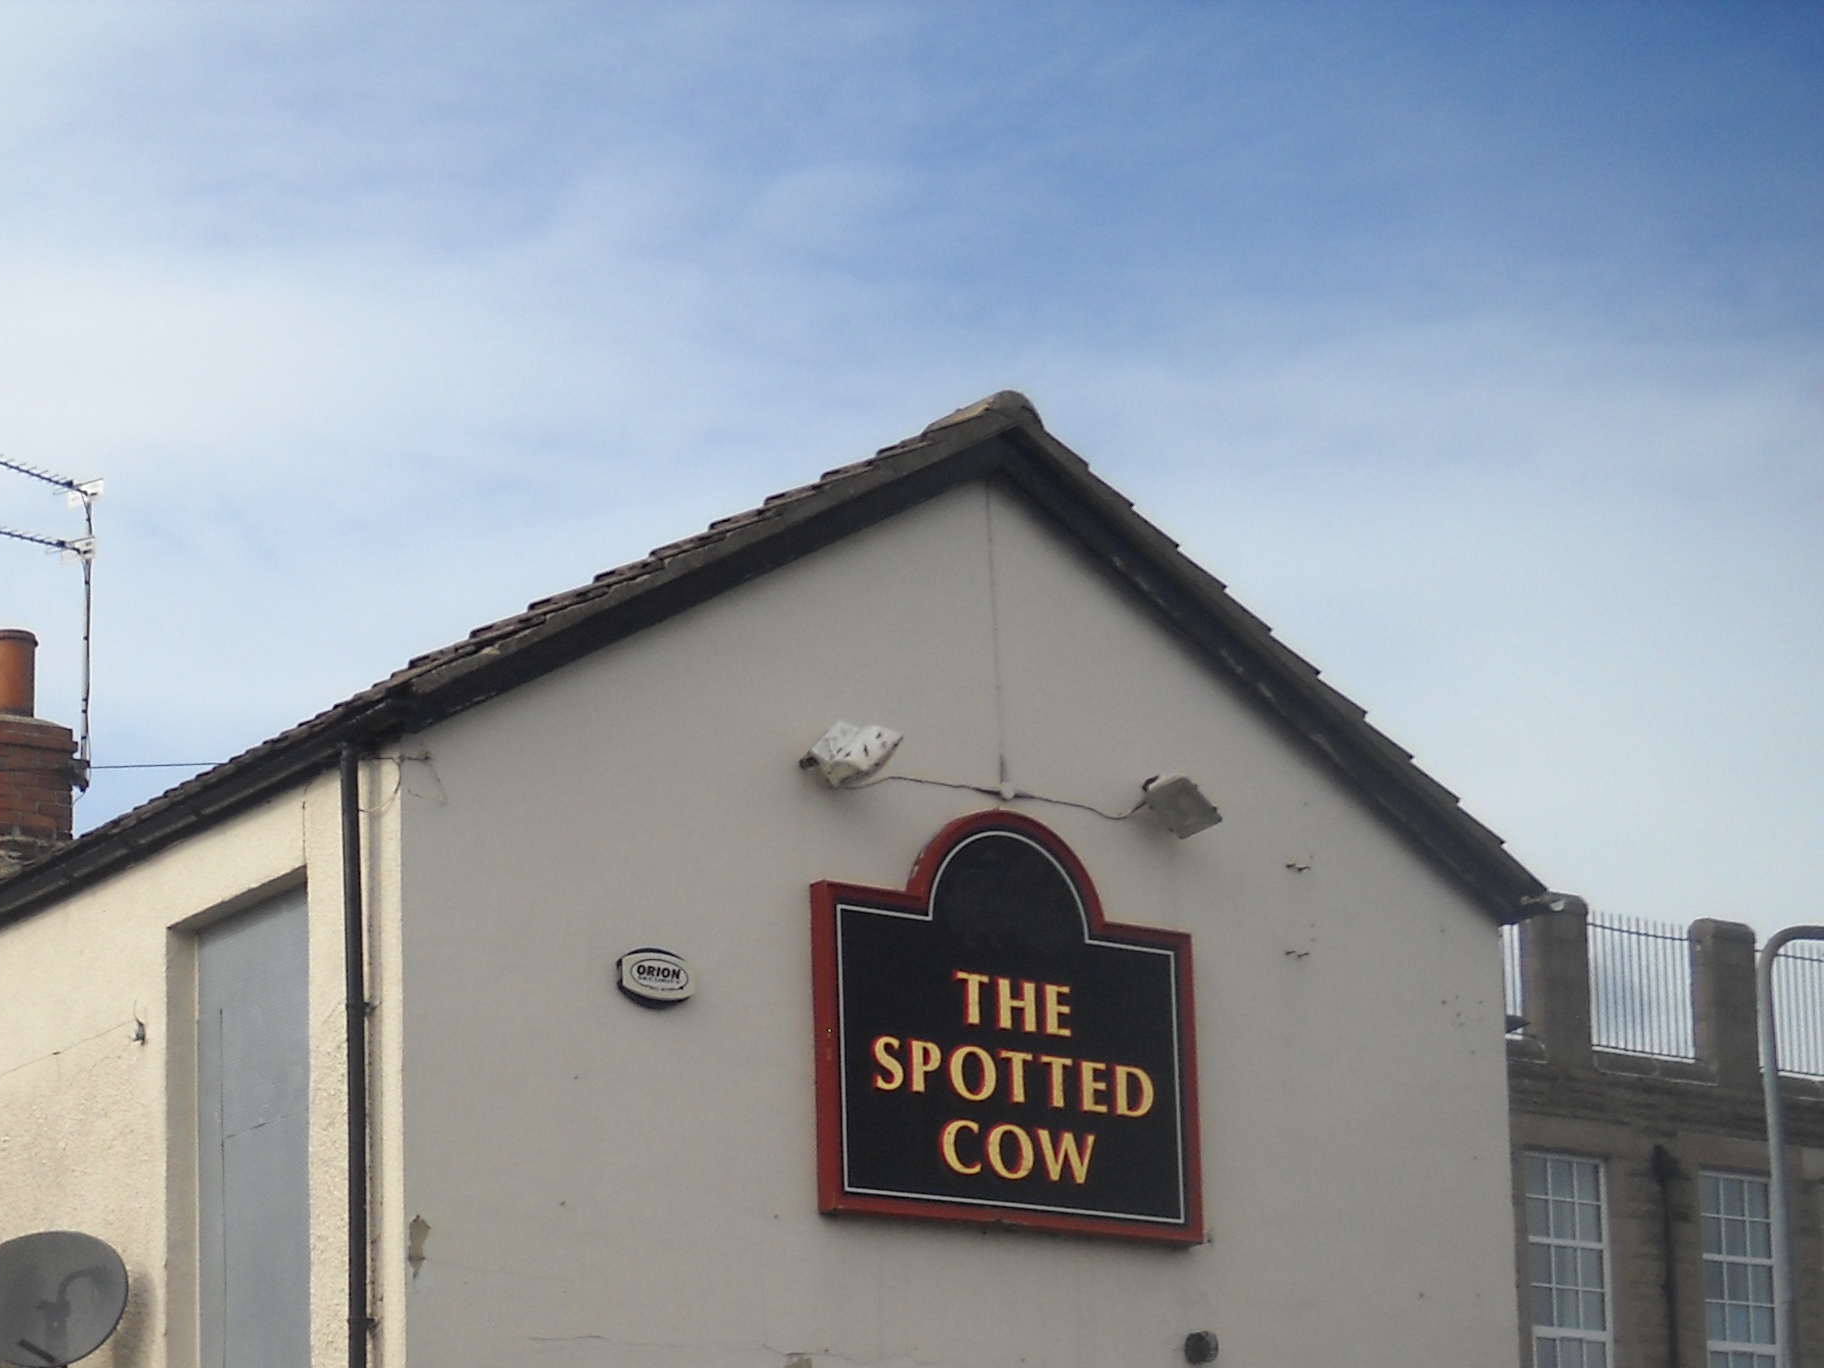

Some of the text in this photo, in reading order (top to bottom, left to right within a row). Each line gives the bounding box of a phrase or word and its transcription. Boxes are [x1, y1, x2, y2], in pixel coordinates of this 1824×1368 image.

[637, 964, 681, 979] ORION
[952, 969, 1072, 1037] THE
[872, 1036, 1155, 1118] SPOTTED
[940, 1119, 1095, 1184] COW
